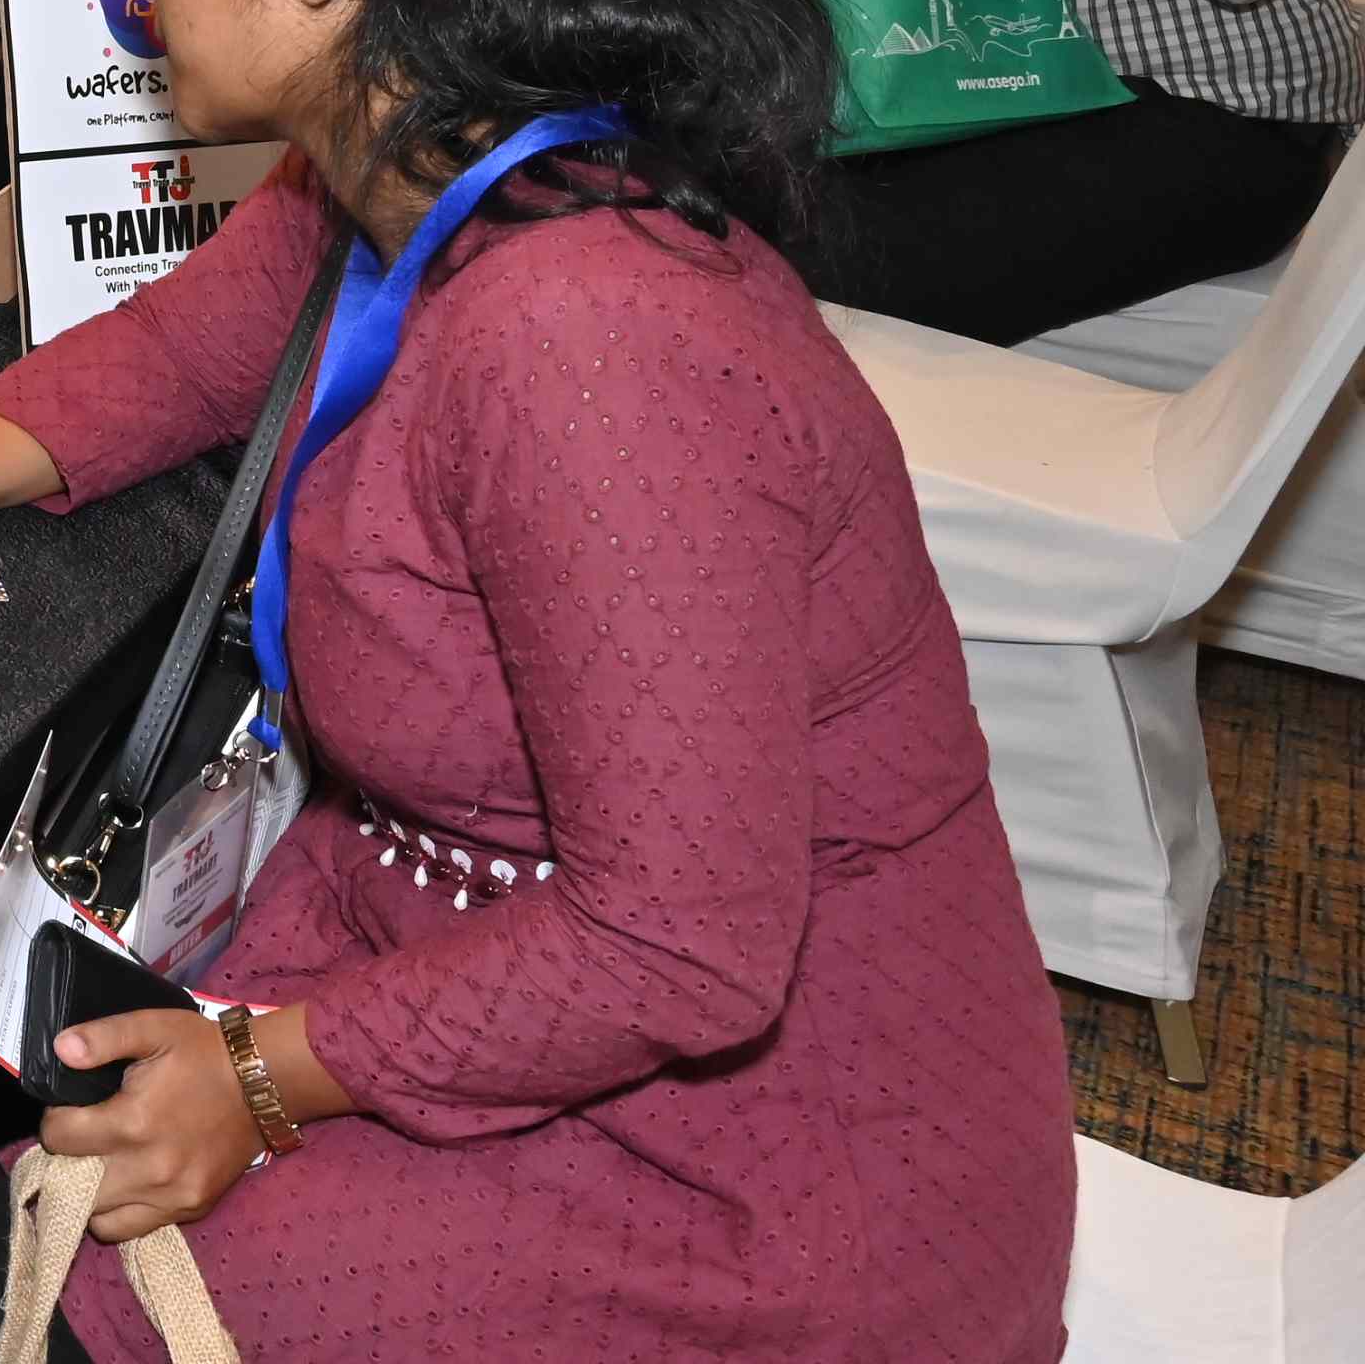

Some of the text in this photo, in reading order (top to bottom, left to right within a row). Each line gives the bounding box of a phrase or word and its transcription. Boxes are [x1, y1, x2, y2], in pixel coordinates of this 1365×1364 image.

[957, 70, 1041, 91] www.asego.in
[65, 200, 239, 263] TRAVMA
[94, 260, 159, 278] Connecting
[105, 280, 132, 294] With
